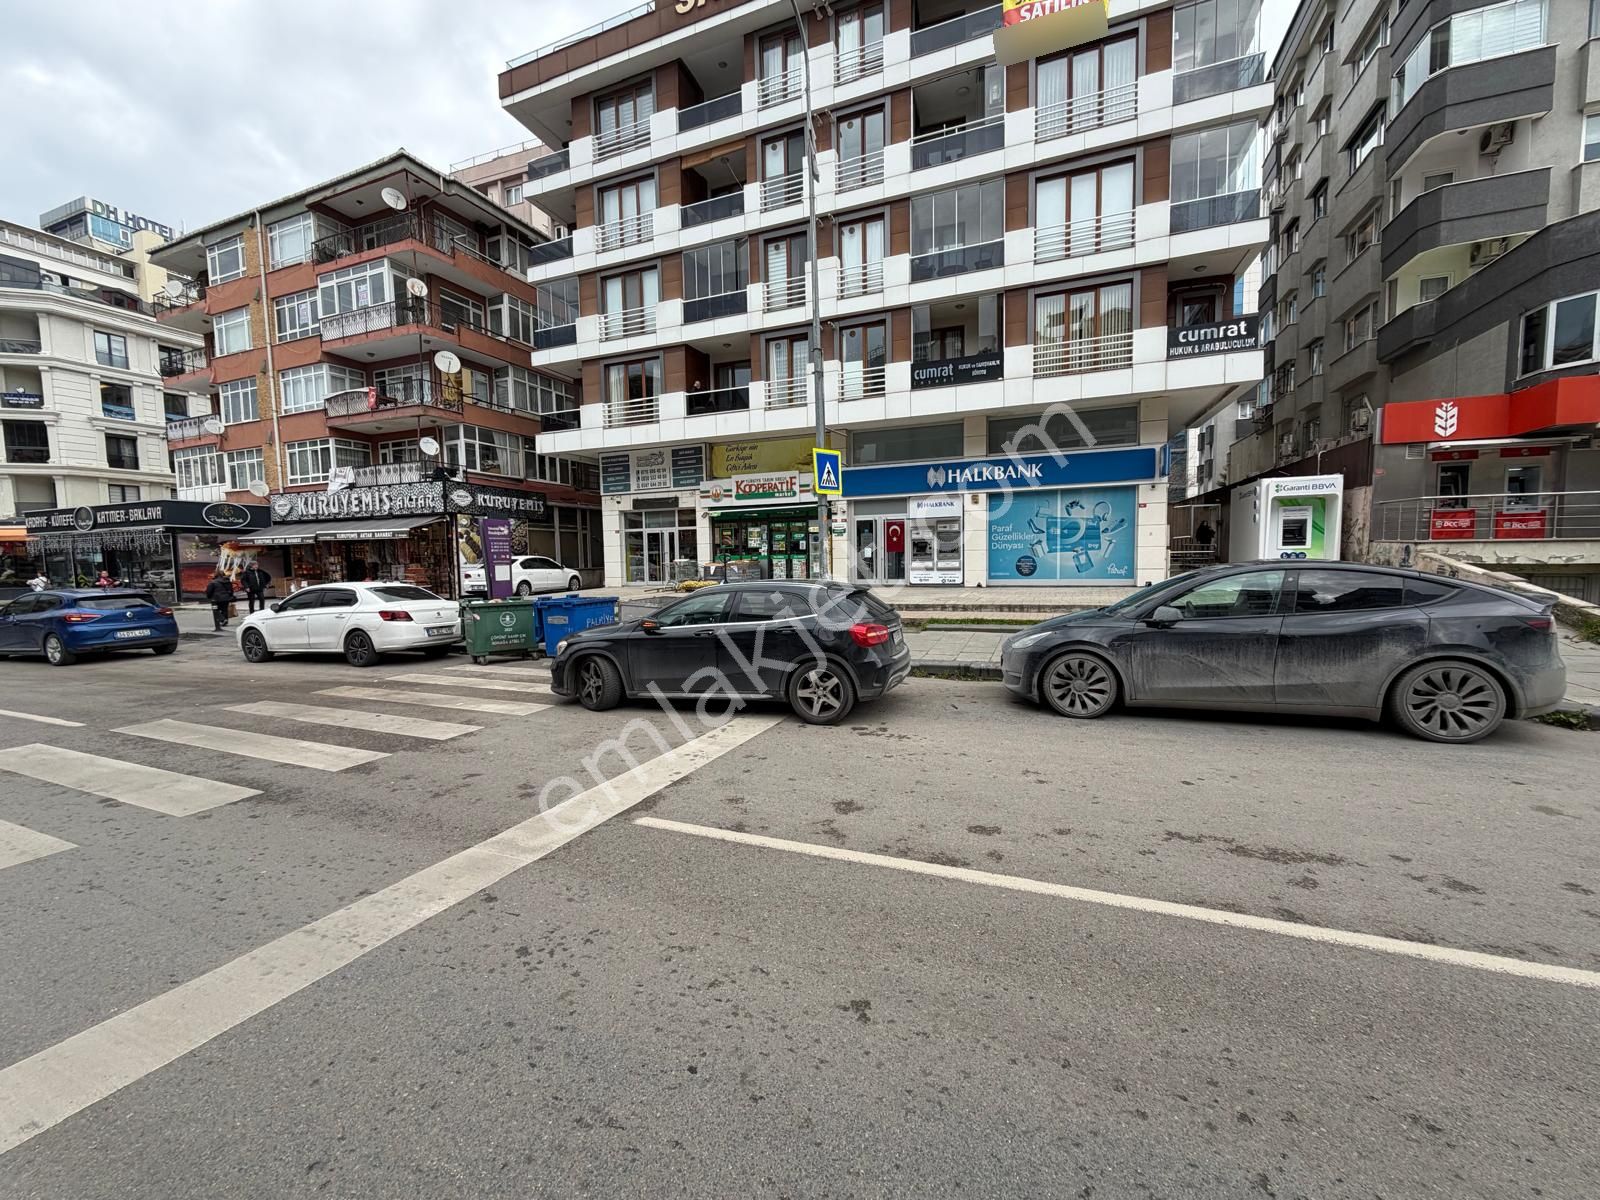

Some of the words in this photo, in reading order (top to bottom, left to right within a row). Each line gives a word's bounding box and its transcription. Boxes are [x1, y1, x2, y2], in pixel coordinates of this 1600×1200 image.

[1178, 319, 1248, 343] cumrat
[1169, 344, 1193, 356] HUKUK
[1200, 337, 1256, 355] ARABULUCULUK
[914, 363, 954, 380] cumrat
[948, 462, 1044, 483] HALKBANK
[1283, 484, 1310, 492] Garanti
[1311, 482, 1337, 490] BBVA
[396, 494, 434, 509] AKTAR
[991, 523, 1013, 532] Paraf
[991, 541, 1024, 551] Dünyası
